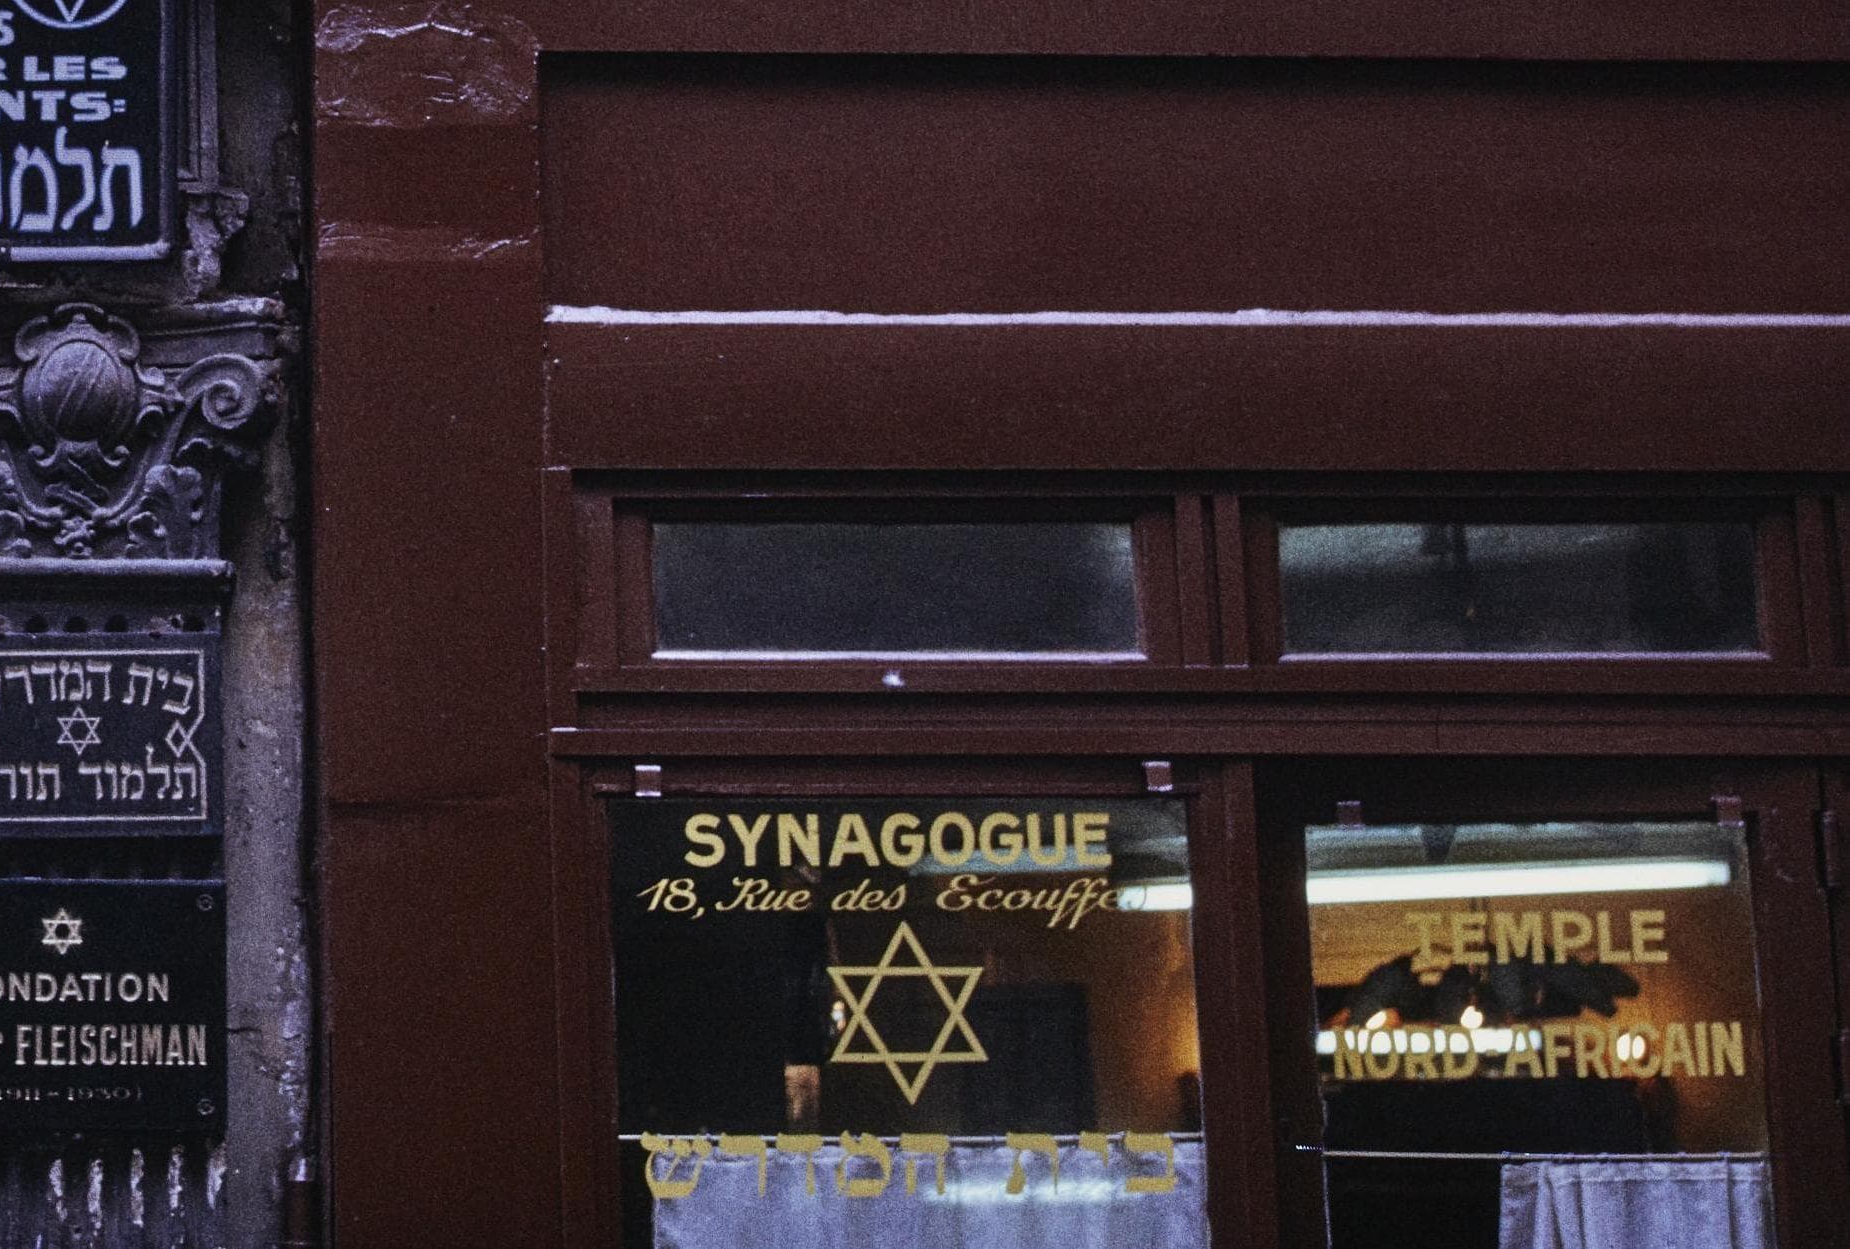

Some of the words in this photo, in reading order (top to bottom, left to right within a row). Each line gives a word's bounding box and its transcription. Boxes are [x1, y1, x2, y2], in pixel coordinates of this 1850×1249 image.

[23, 55, 129, 82] LES
[122, 661, 194, 716] בית
[78, 742, 197, 800] תלמוד
[685, 812, 1112, 868] SYNAGOGUE
[636, 877, 705, 920] 18,
[714, 875, 811, 912] Rue
[830, 878, 907, 912] des
[1403, 909, 1669, 965] TEMPLE
[15, 1024, 208, 1067] FLEISCHMAN
[1006, 1130, 1177, 1195] בית
